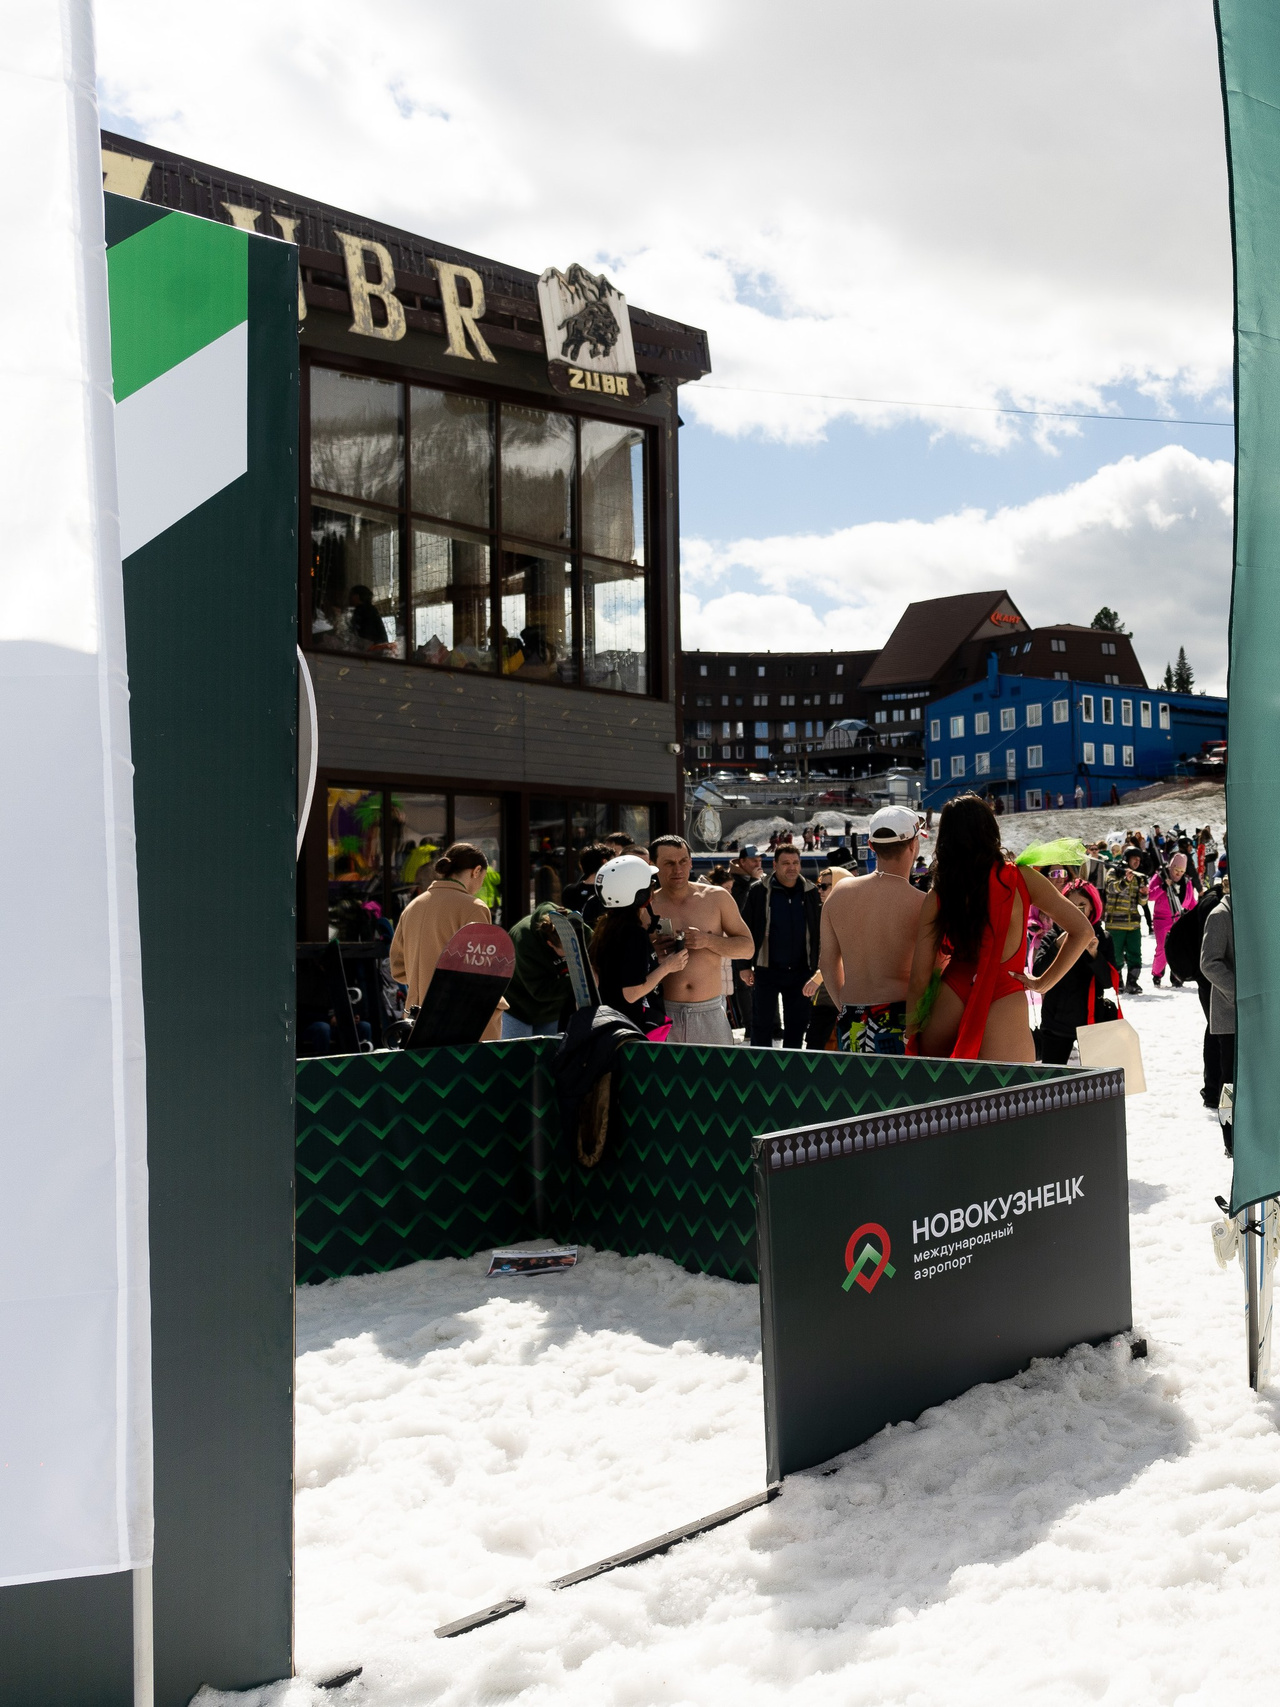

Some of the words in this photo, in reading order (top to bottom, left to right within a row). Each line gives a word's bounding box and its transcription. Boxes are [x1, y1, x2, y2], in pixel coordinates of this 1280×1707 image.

[568, 368, 629, 397] ZUBR
[912, 1175, 1085, 1244] НОВОКУЗНЕЦК
[913, 1222, 1014, 1263] международный
[913, 1253, 973, 1280] аэропорт
